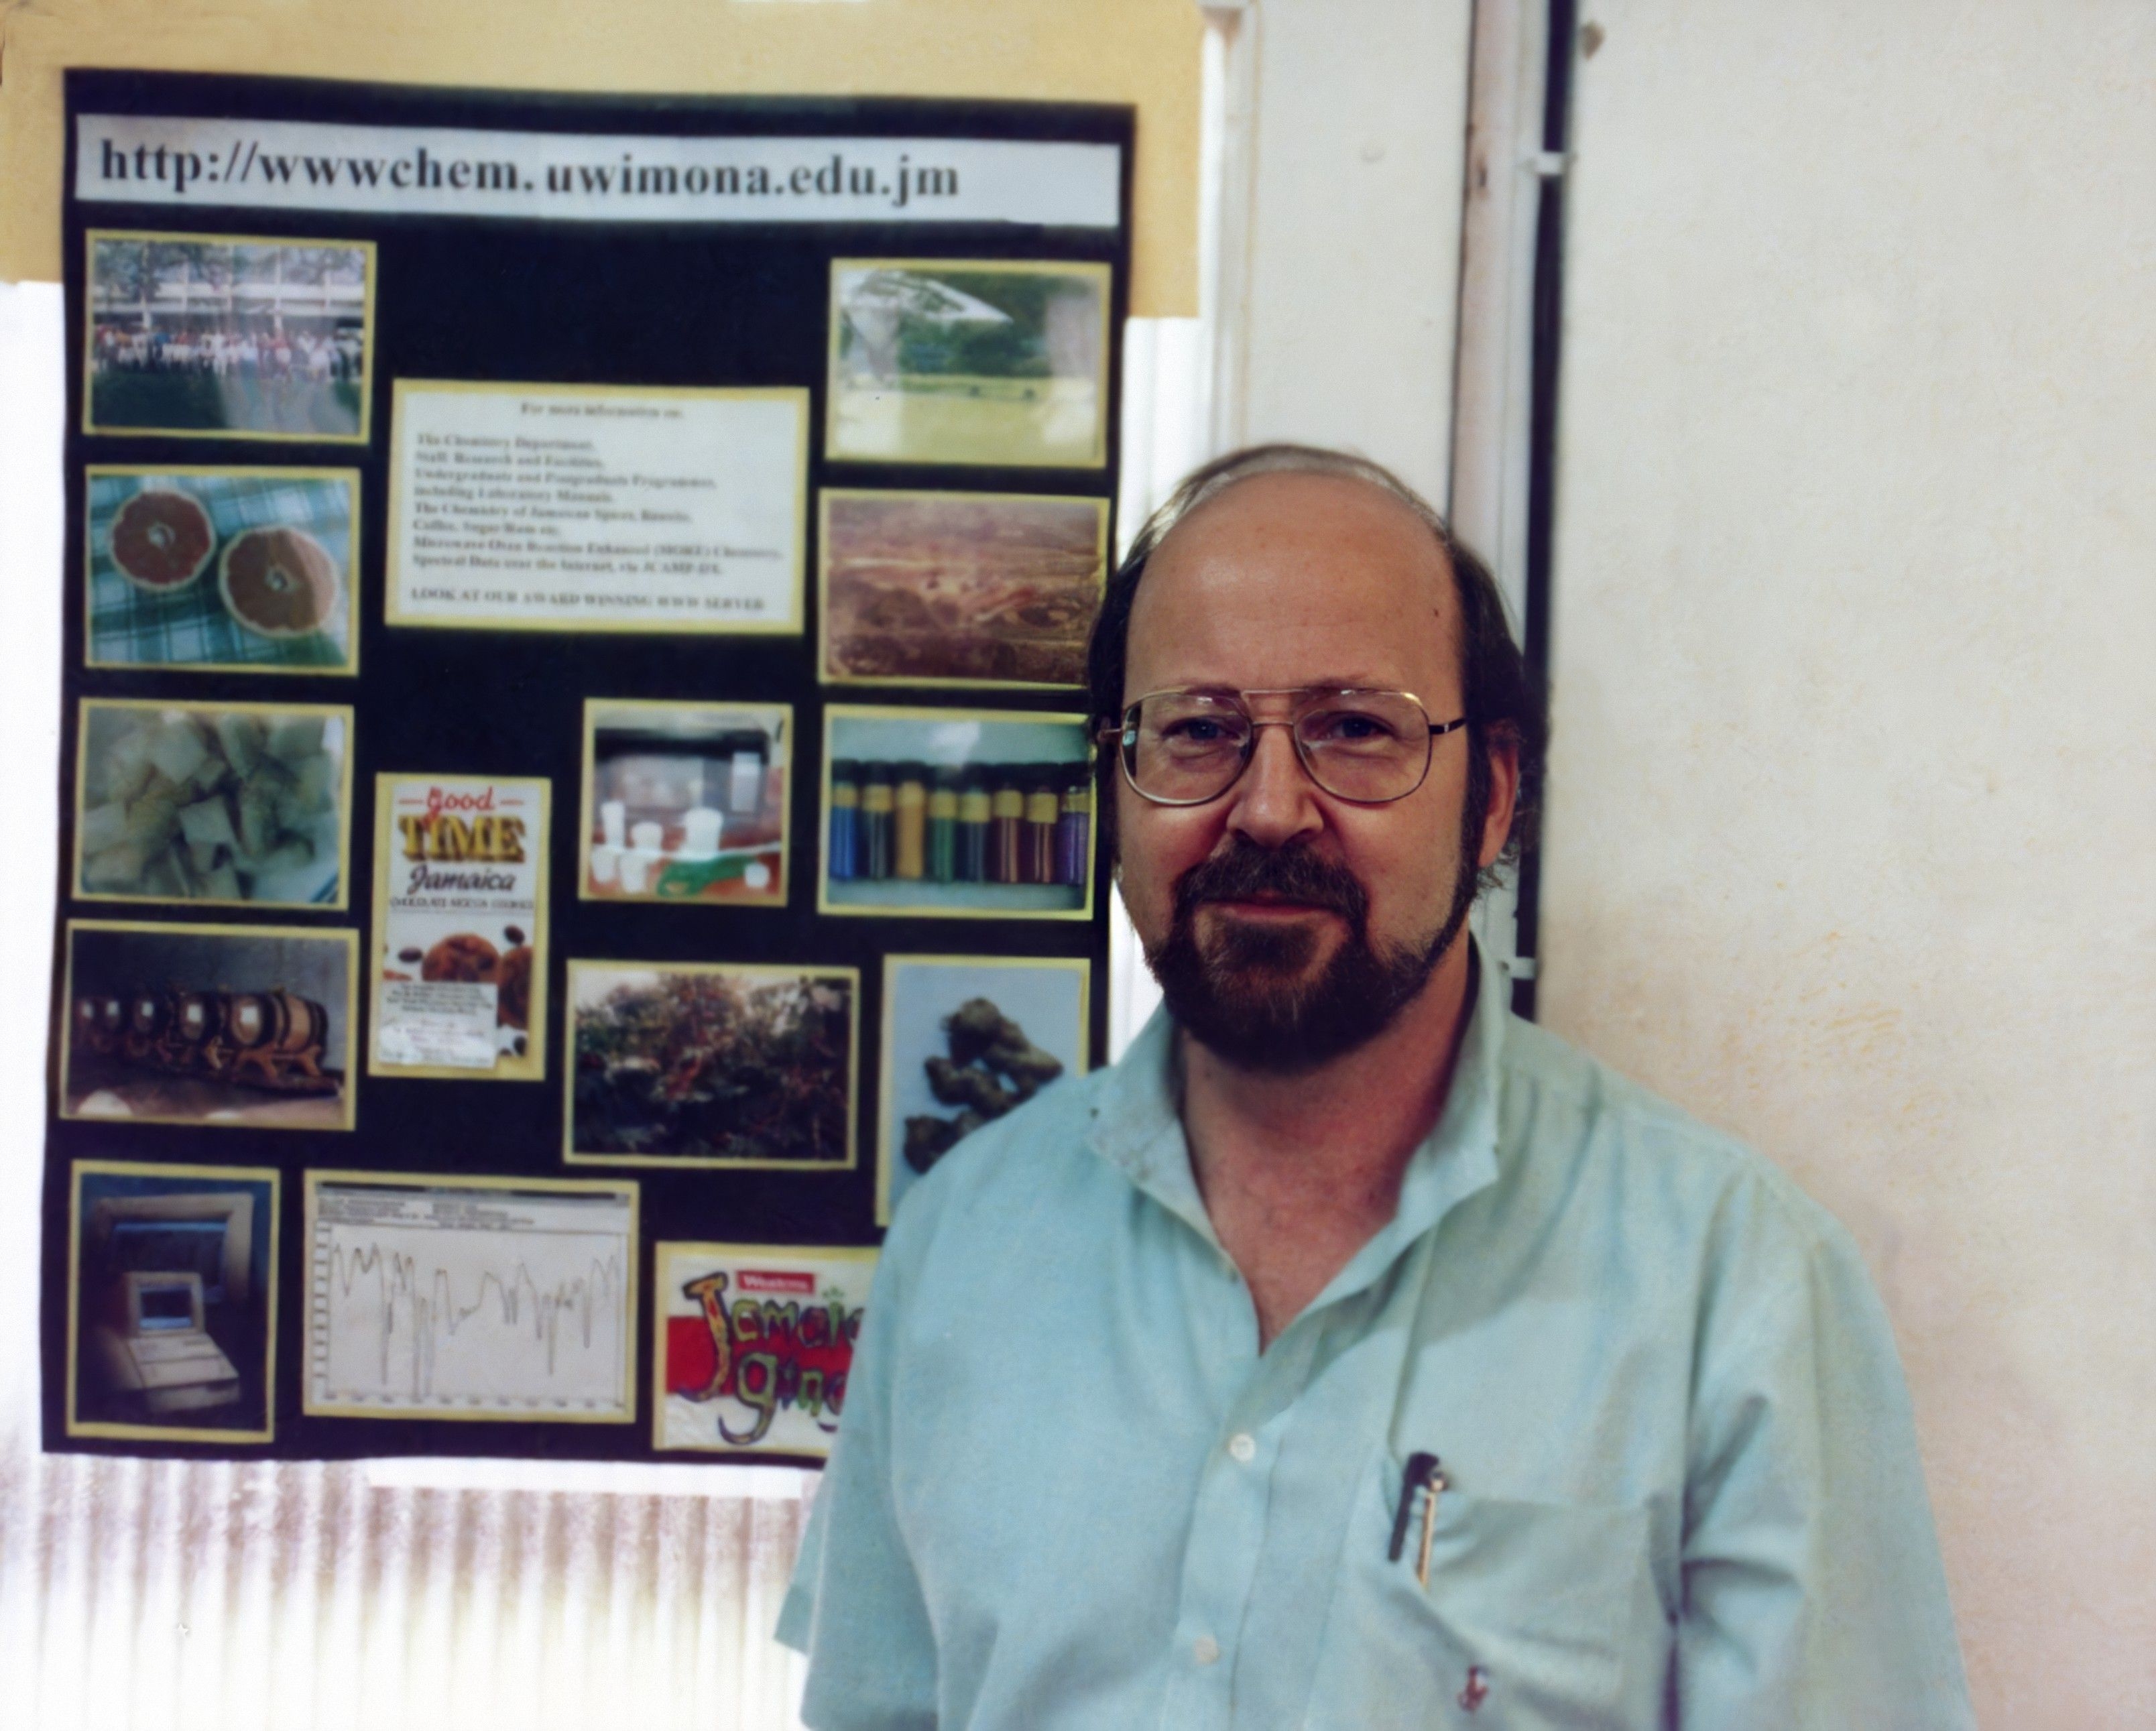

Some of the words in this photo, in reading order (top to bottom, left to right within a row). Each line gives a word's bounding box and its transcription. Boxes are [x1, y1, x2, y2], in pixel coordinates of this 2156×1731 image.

[411, 587, 455, 602] LOOK
[462, 589, 481, 602] AT
[485, 590, 518, 603] OUR
[398, 814, 526, 864] TIME
[406, 863, 516, 896] Jamaica
